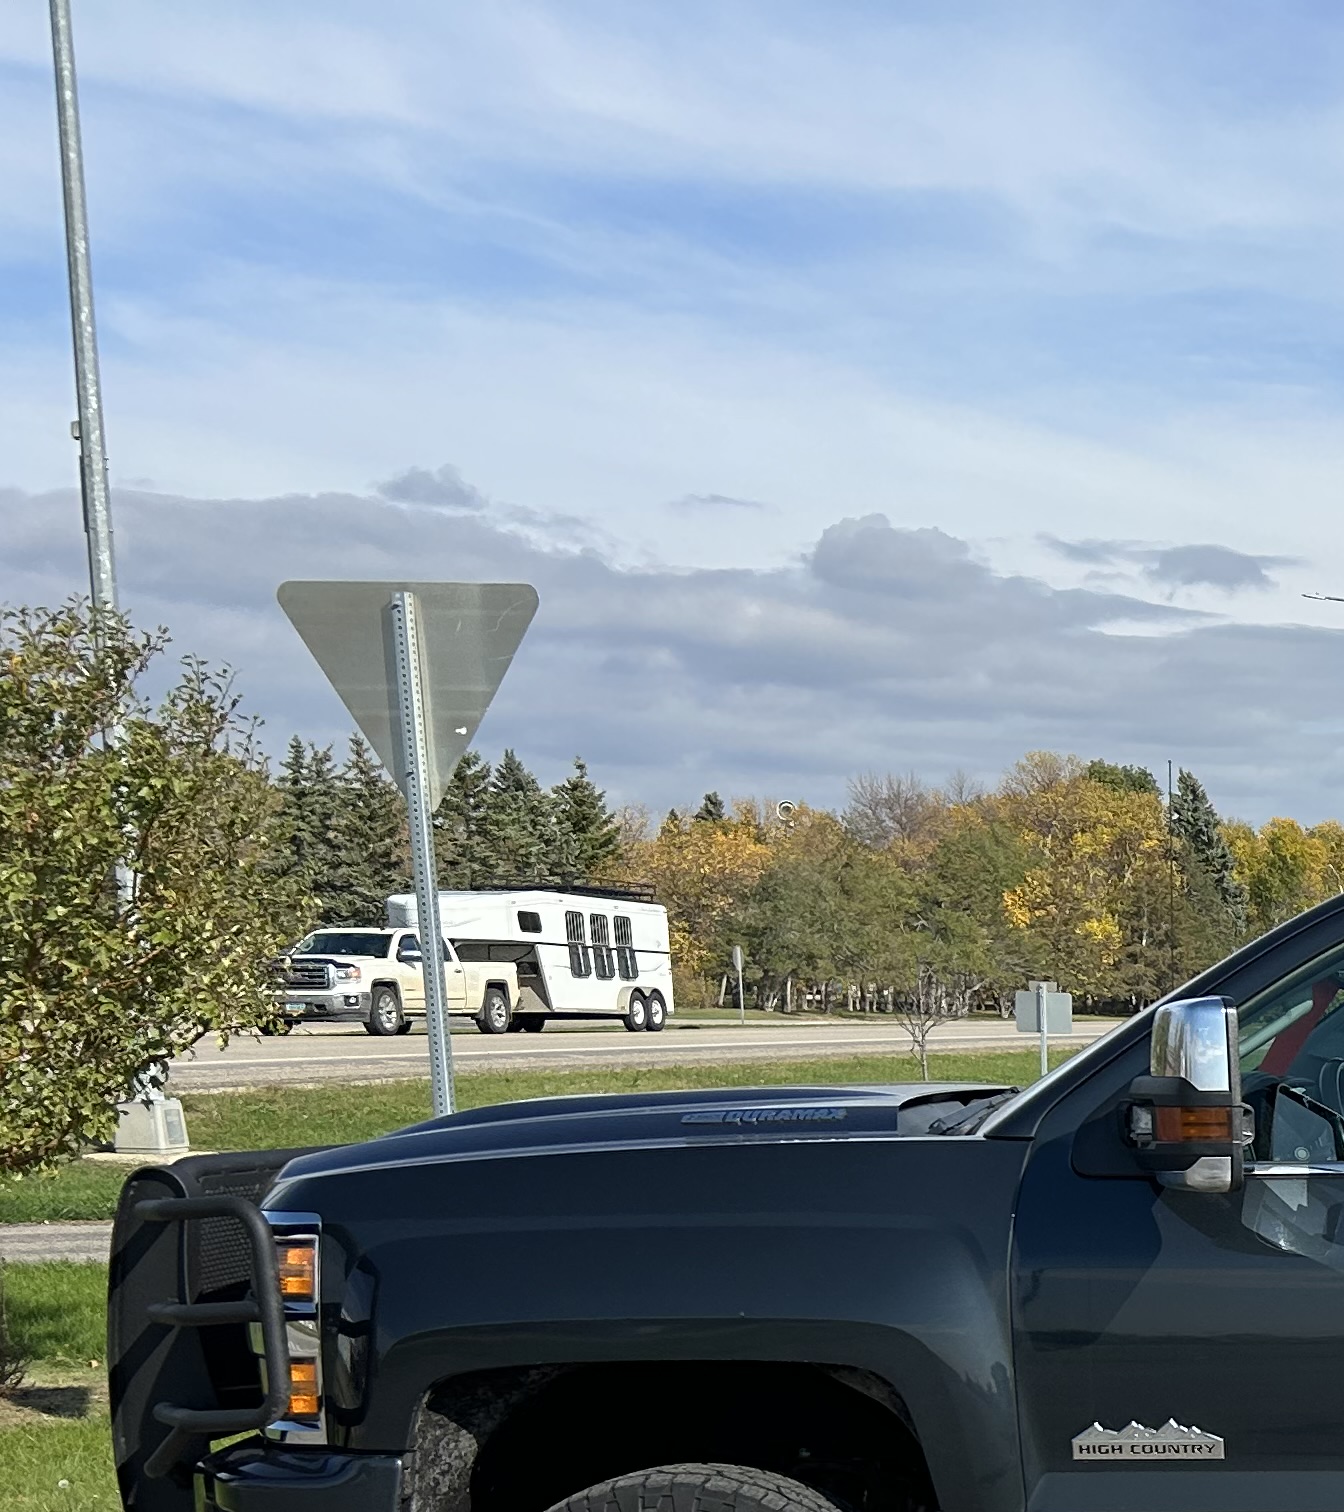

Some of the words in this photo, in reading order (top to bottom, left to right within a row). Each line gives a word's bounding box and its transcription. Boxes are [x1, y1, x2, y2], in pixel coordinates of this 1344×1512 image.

[724, 1107, 848, 1123] DURAMAX
[1079, 1444, 1123, 1455] HIGH
[1130, 1443, 1216, 1455] COUNTRY
